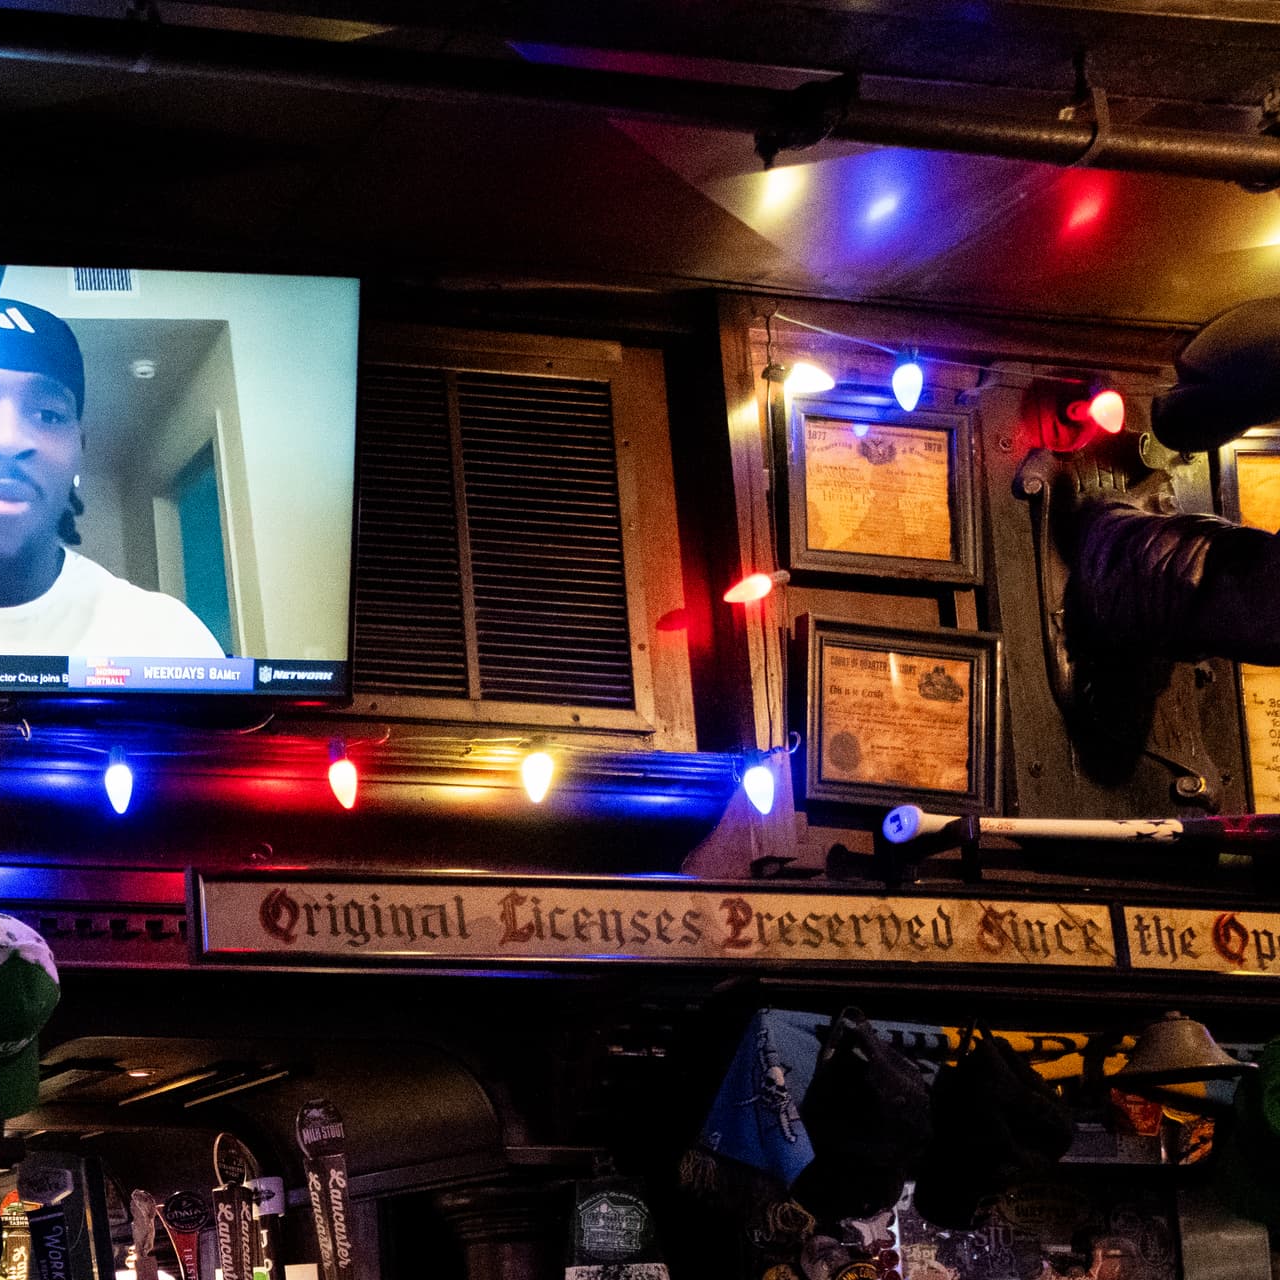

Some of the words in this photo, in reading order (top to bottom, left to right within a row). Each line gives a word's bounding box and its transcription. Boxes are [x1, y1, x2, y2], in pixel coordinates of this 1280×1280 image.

[18, 674, 39, 683] Cruz
[40, 674, 60, 685] joins
[144, 666, 205, 680] WEEKDAYS
[273, 670, 333, 681] NETWORK
[259, 888, 471, 946] Original
[498, 888, 703, 950] Licenses
[721, 897, 954, 951] Preserved
[977, 904, 1113, 958] Since
[1133, 914, 1201, 964] the
[302, 1128, 321, 1145] MILK
[321, 1122, 344, 1140] STOUT
[308, 1170, 333, 1271] Lancaster
[328, 1167, 352, 1271] Lancaster
